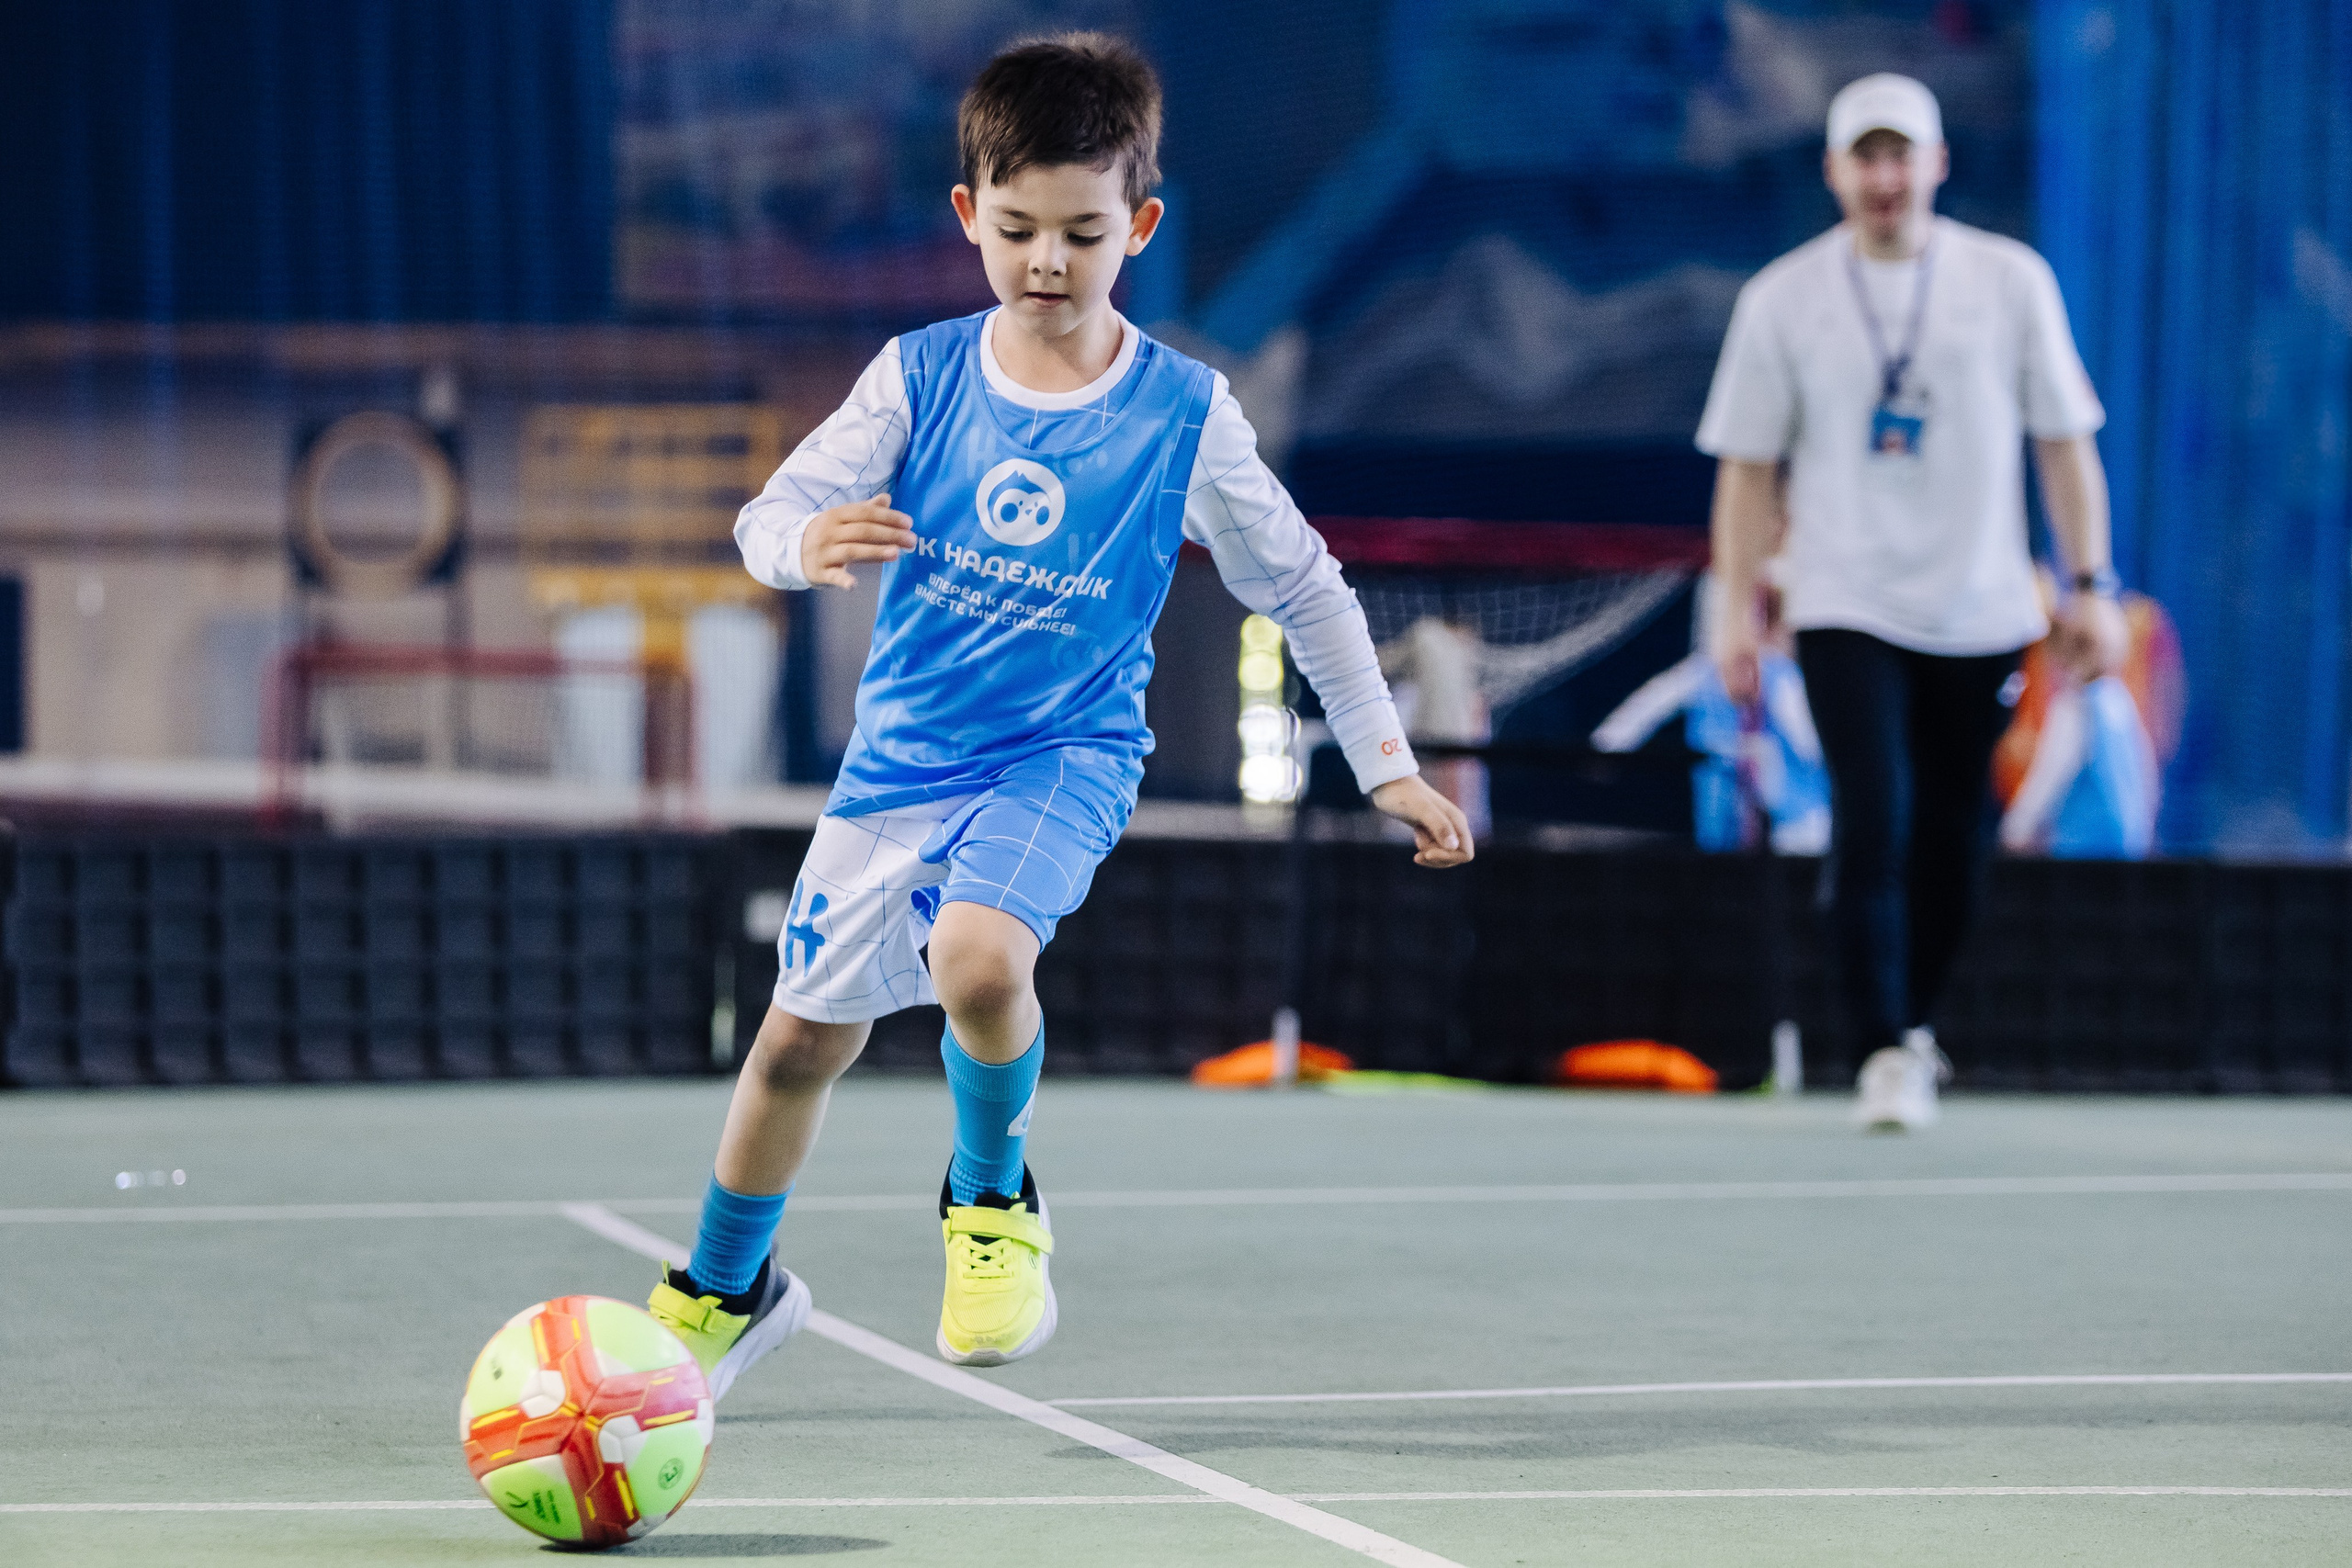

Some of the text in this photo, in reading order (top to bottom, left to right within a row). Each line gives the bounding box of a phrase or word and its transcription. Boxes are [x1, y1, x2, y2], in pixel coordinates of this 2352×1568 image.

[928, 572, 982, 606] ВПЕРЁД
[985, 594, 998, 607] К
[944, 542, 1114, 600] НАДЕЖДИК
[914, 583, 967, 615] ВМЕСТЕ
[968, 606, 998, 625] МЫ
